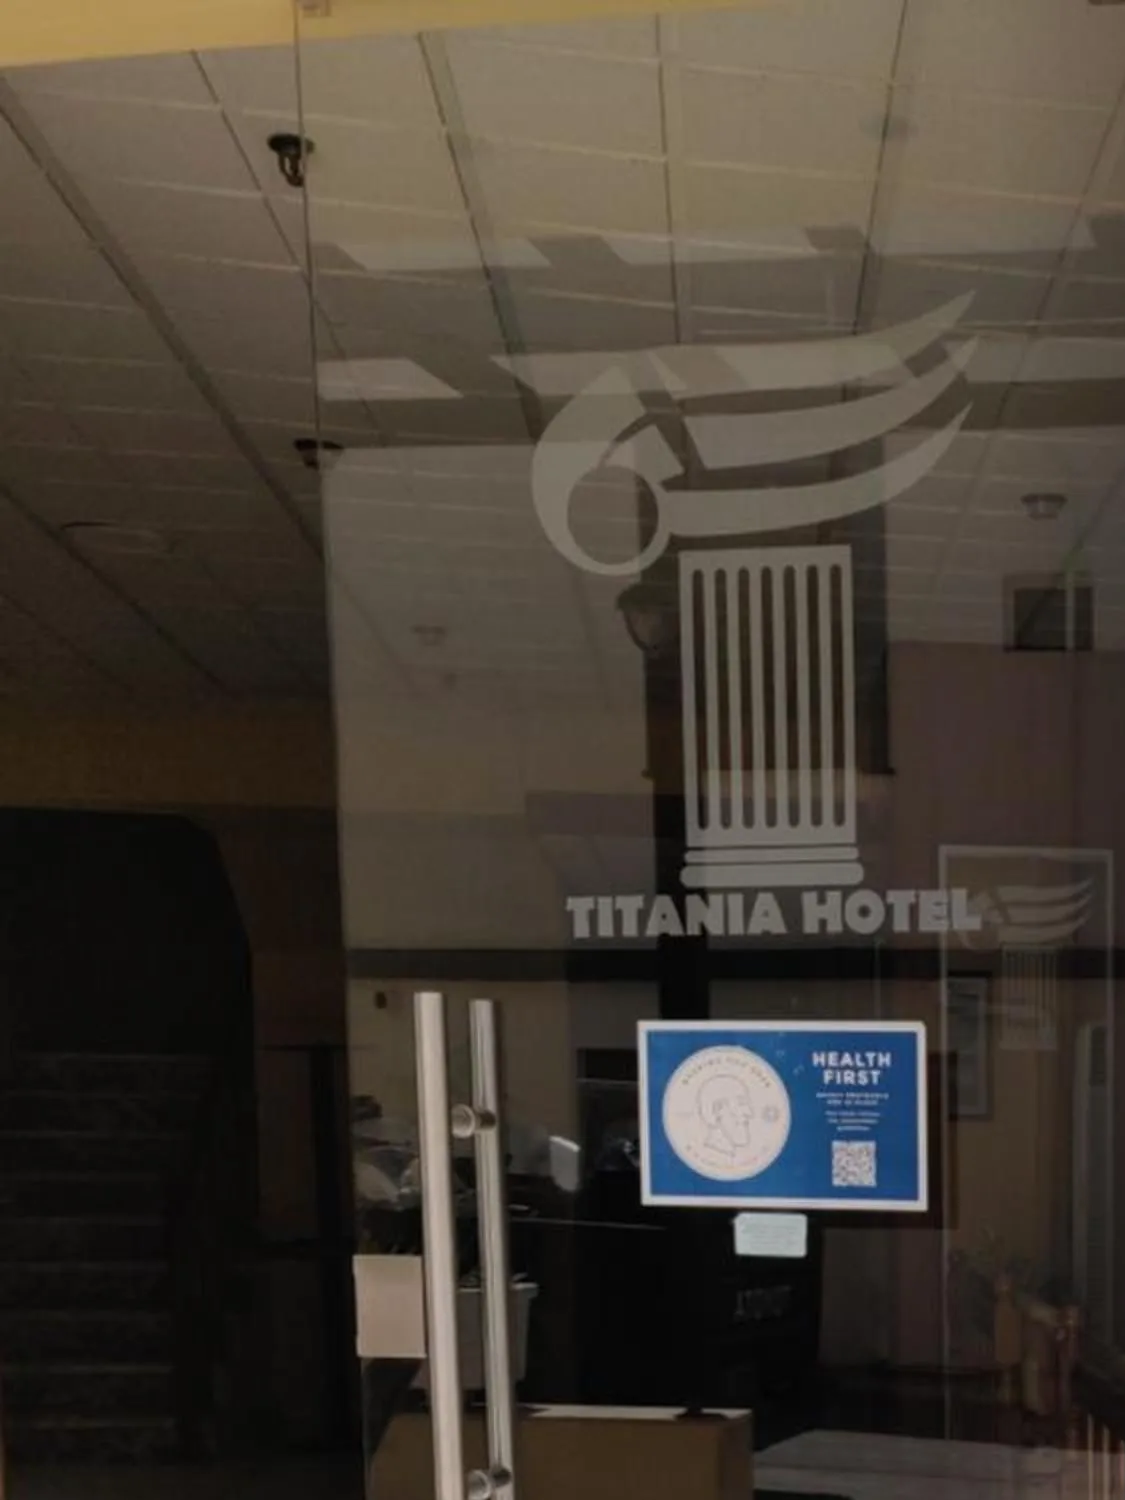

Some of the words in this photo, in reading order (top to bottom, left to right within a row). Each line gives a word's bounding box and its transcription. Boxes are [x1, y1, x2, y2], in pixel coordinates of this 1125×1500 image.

[565, 891, 788, 939] TITANIA
[801, 888, 982, 935] HOTEL
[812, 1051, 892, 1068] HEALTH
[823, 1070, 882, 1086] FIRST
